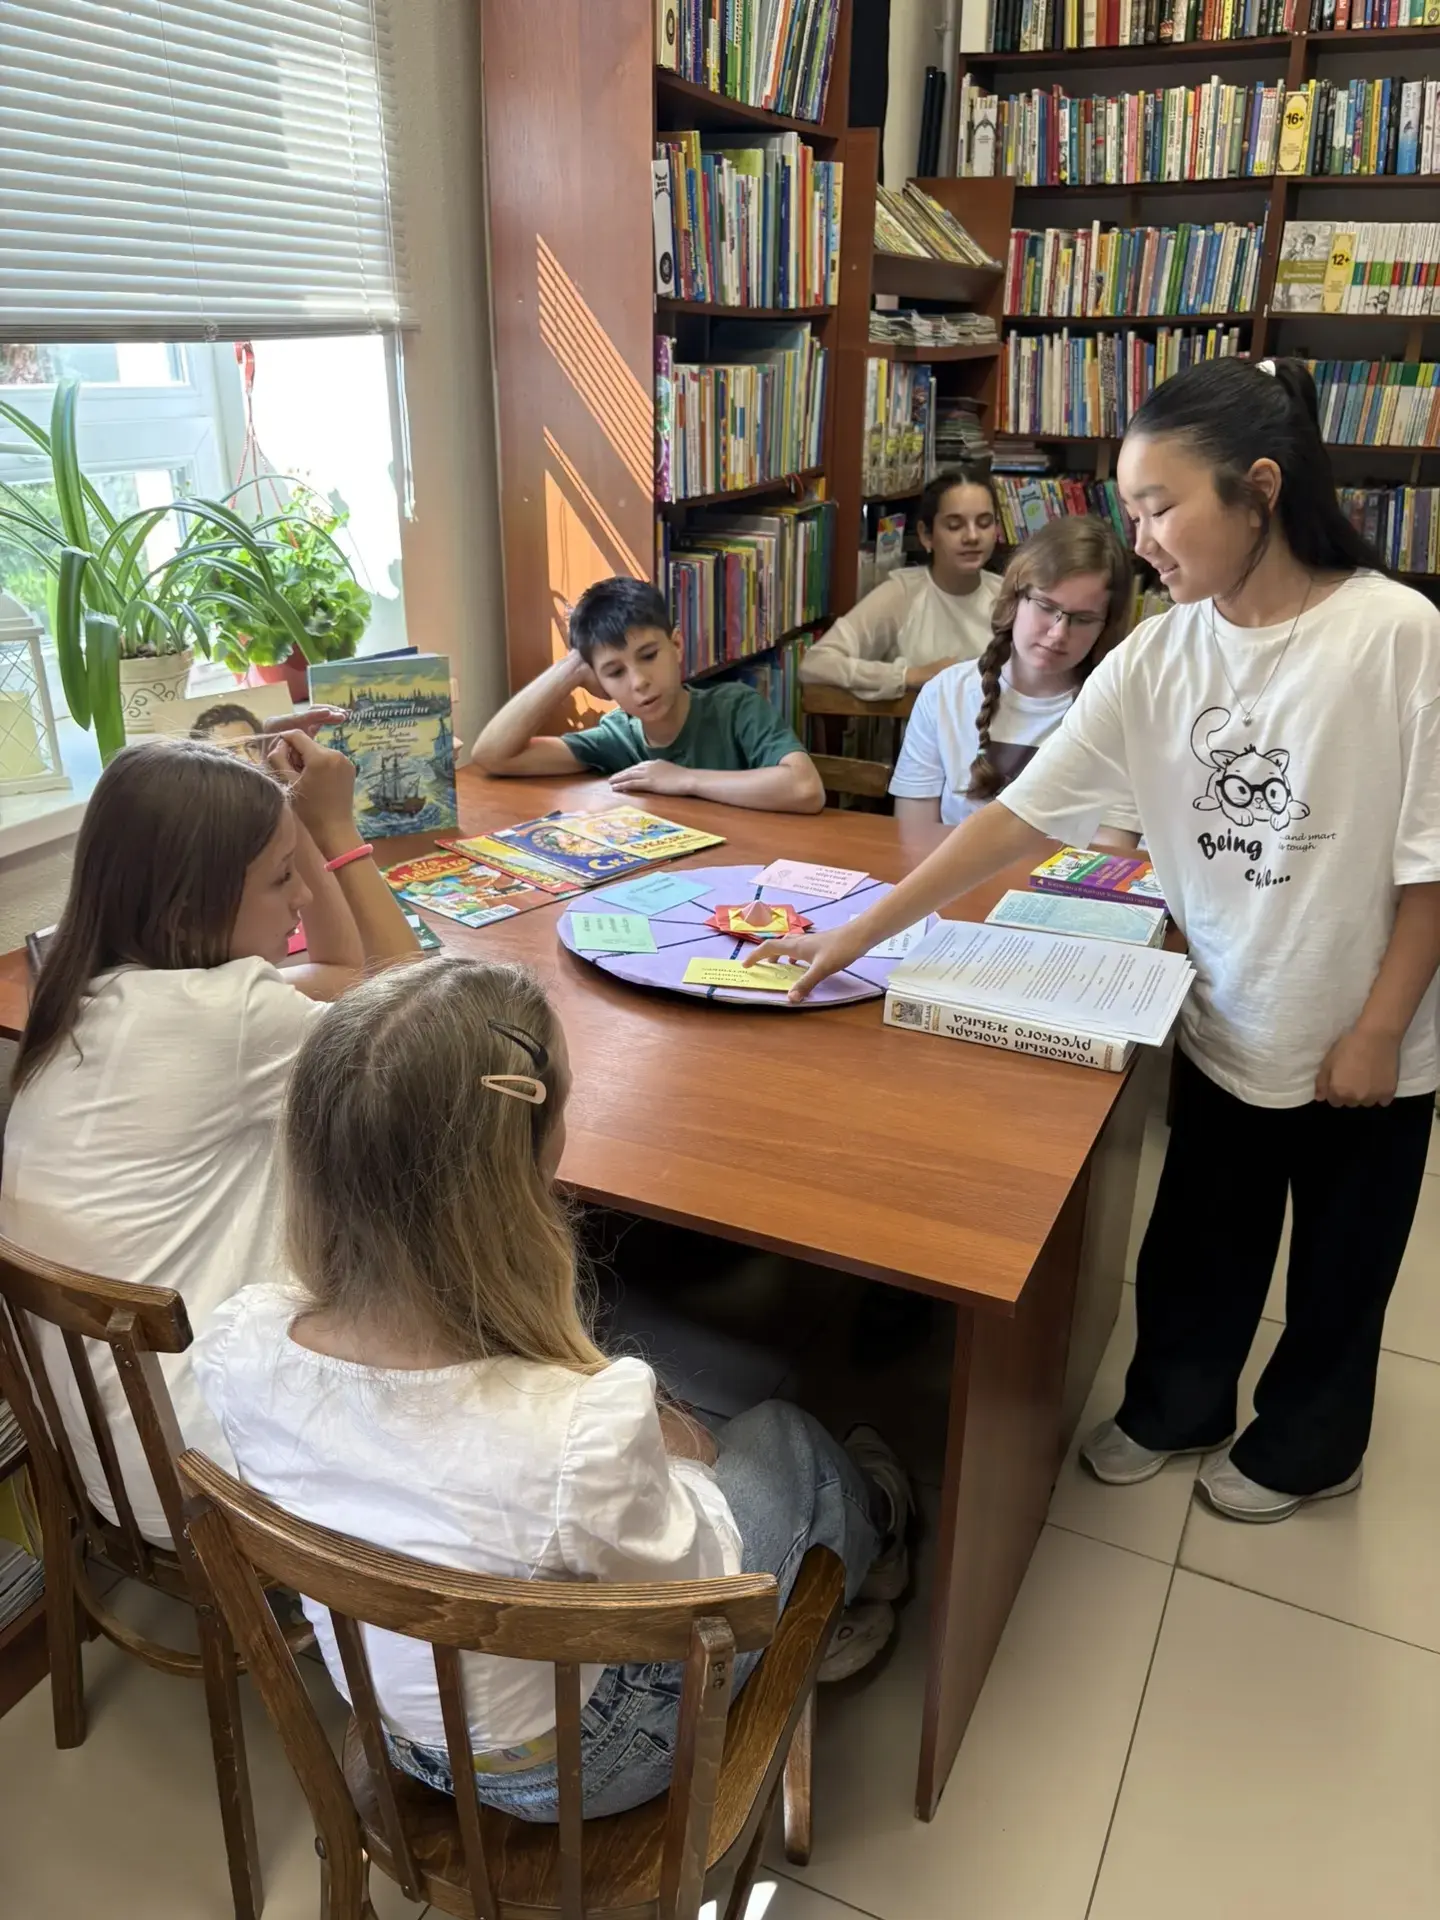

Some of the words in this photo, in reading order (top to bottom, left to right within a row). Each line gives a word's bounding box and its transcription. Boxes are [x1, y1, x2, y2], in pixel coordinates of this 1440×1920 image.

[1286, 113, 1305, 125] 16+
[1332, 254, 1351, 266] 12+
[1307, 832, 1337, 841] smart
[1197, 828, 1263, 861] Being
[1286, 842, 1317, 853] tough
